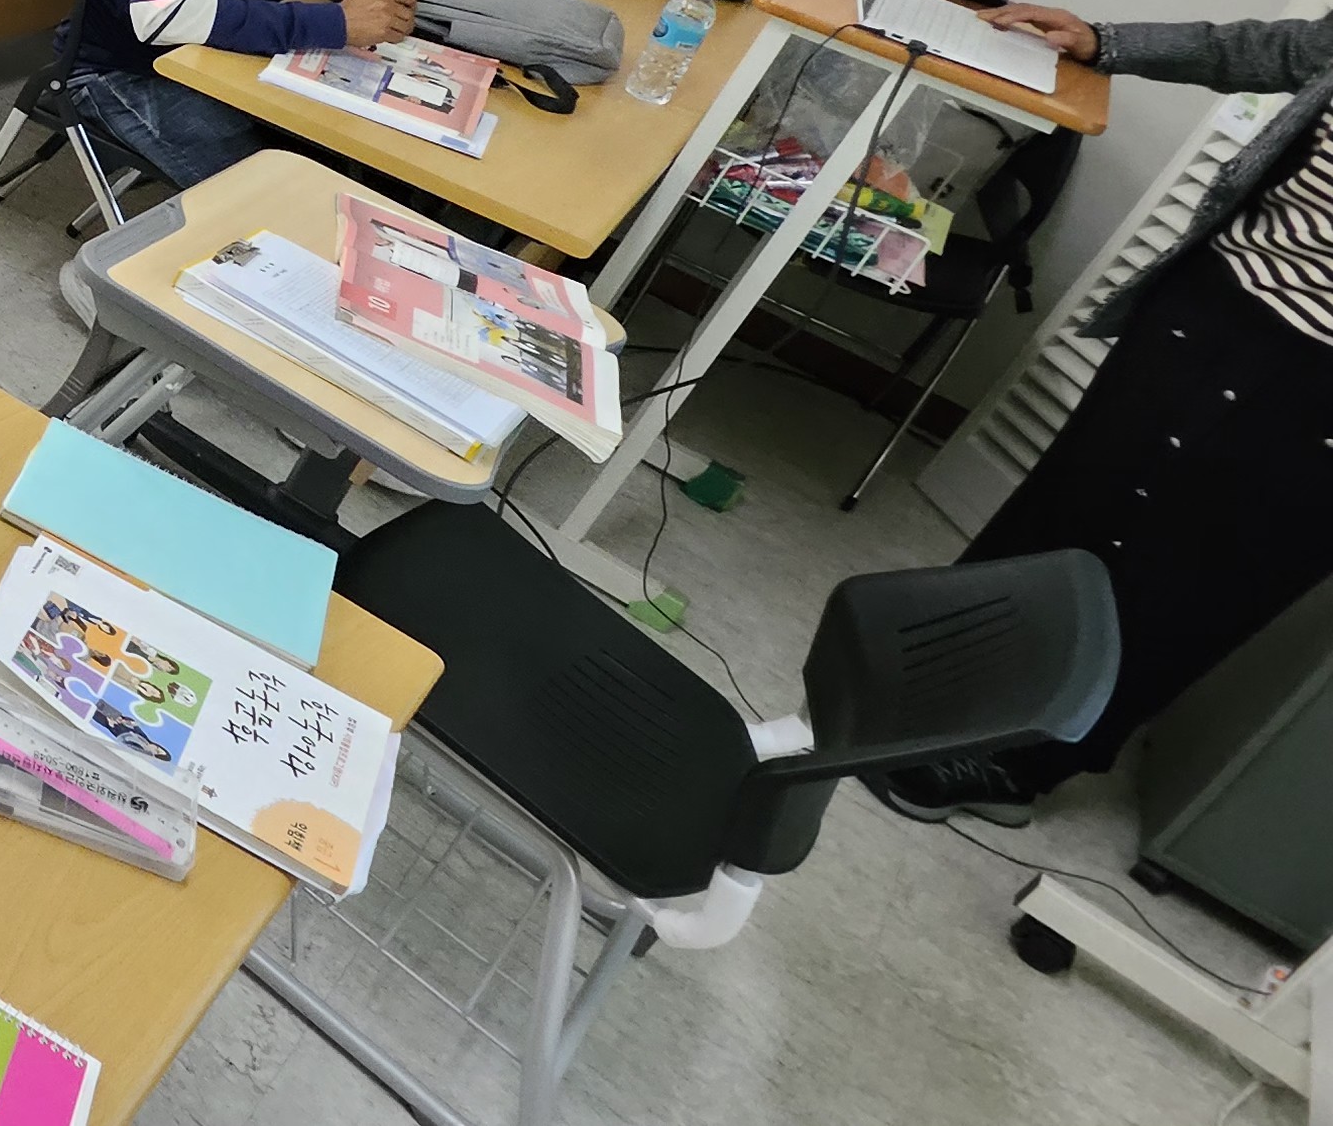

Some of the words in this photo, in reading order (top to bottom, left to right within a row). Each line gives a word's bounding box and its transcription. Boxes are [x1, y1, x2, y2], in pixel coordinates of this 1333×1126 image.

[222, 670, 287, 744] 한국문화
[280, 699, 341, 778] 한국어와
[285, 822, 308, 852] 익힘책
